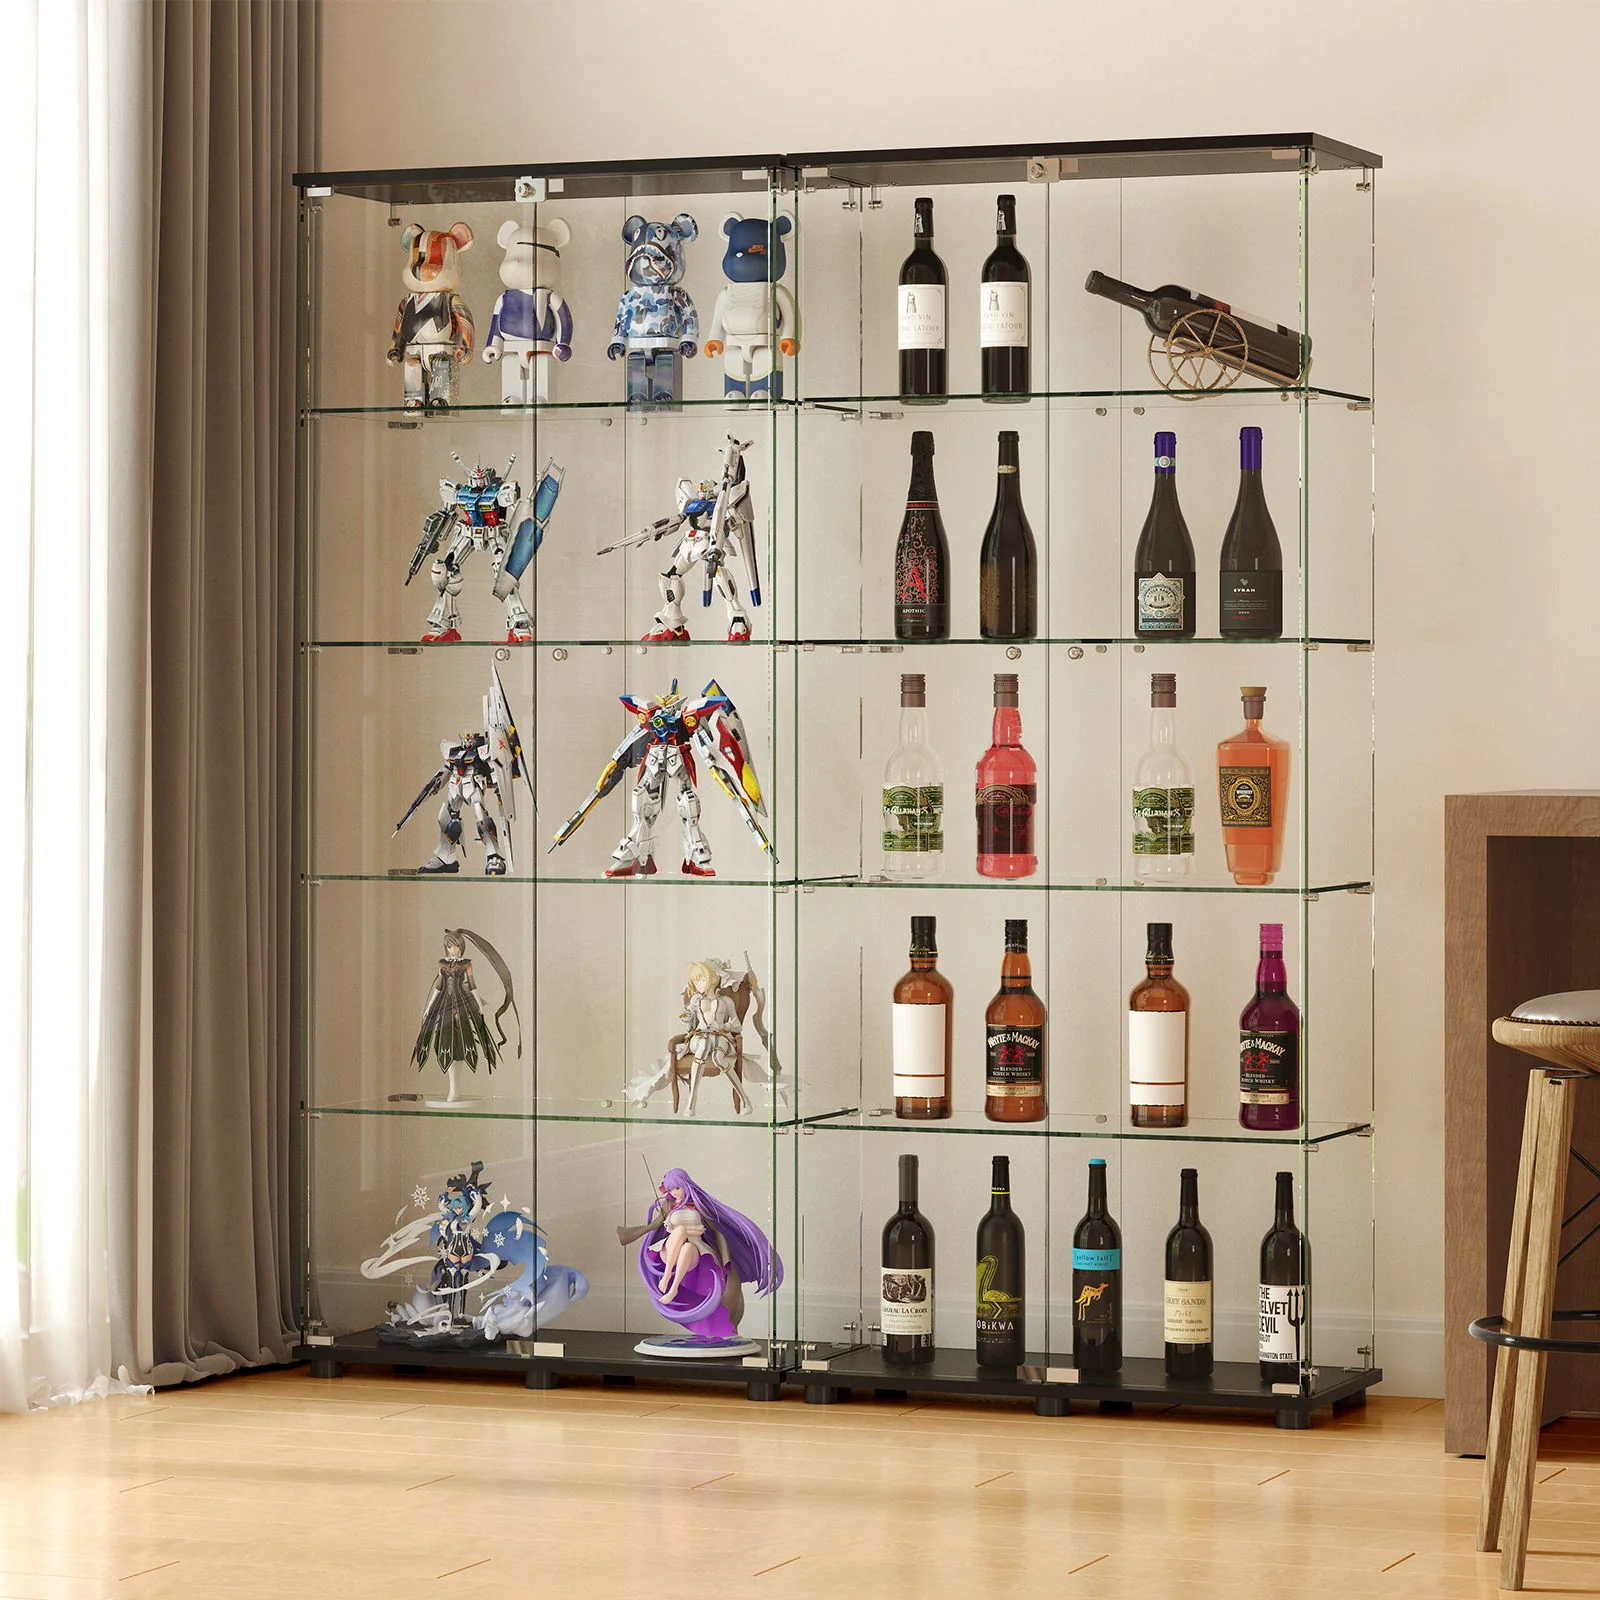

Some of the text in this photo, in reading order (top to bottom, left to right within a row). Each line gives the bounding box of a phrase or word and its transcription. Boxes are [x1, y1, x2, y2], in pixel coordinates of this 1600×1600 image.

[1011, 1031, 1040, 1050] MACKAY
[1255, 1038, 1286, 1056] MACKAY
[1180, 1297, 1206, 1306] SANDS
[1260, 1300, 1289, 1315] ELVET
